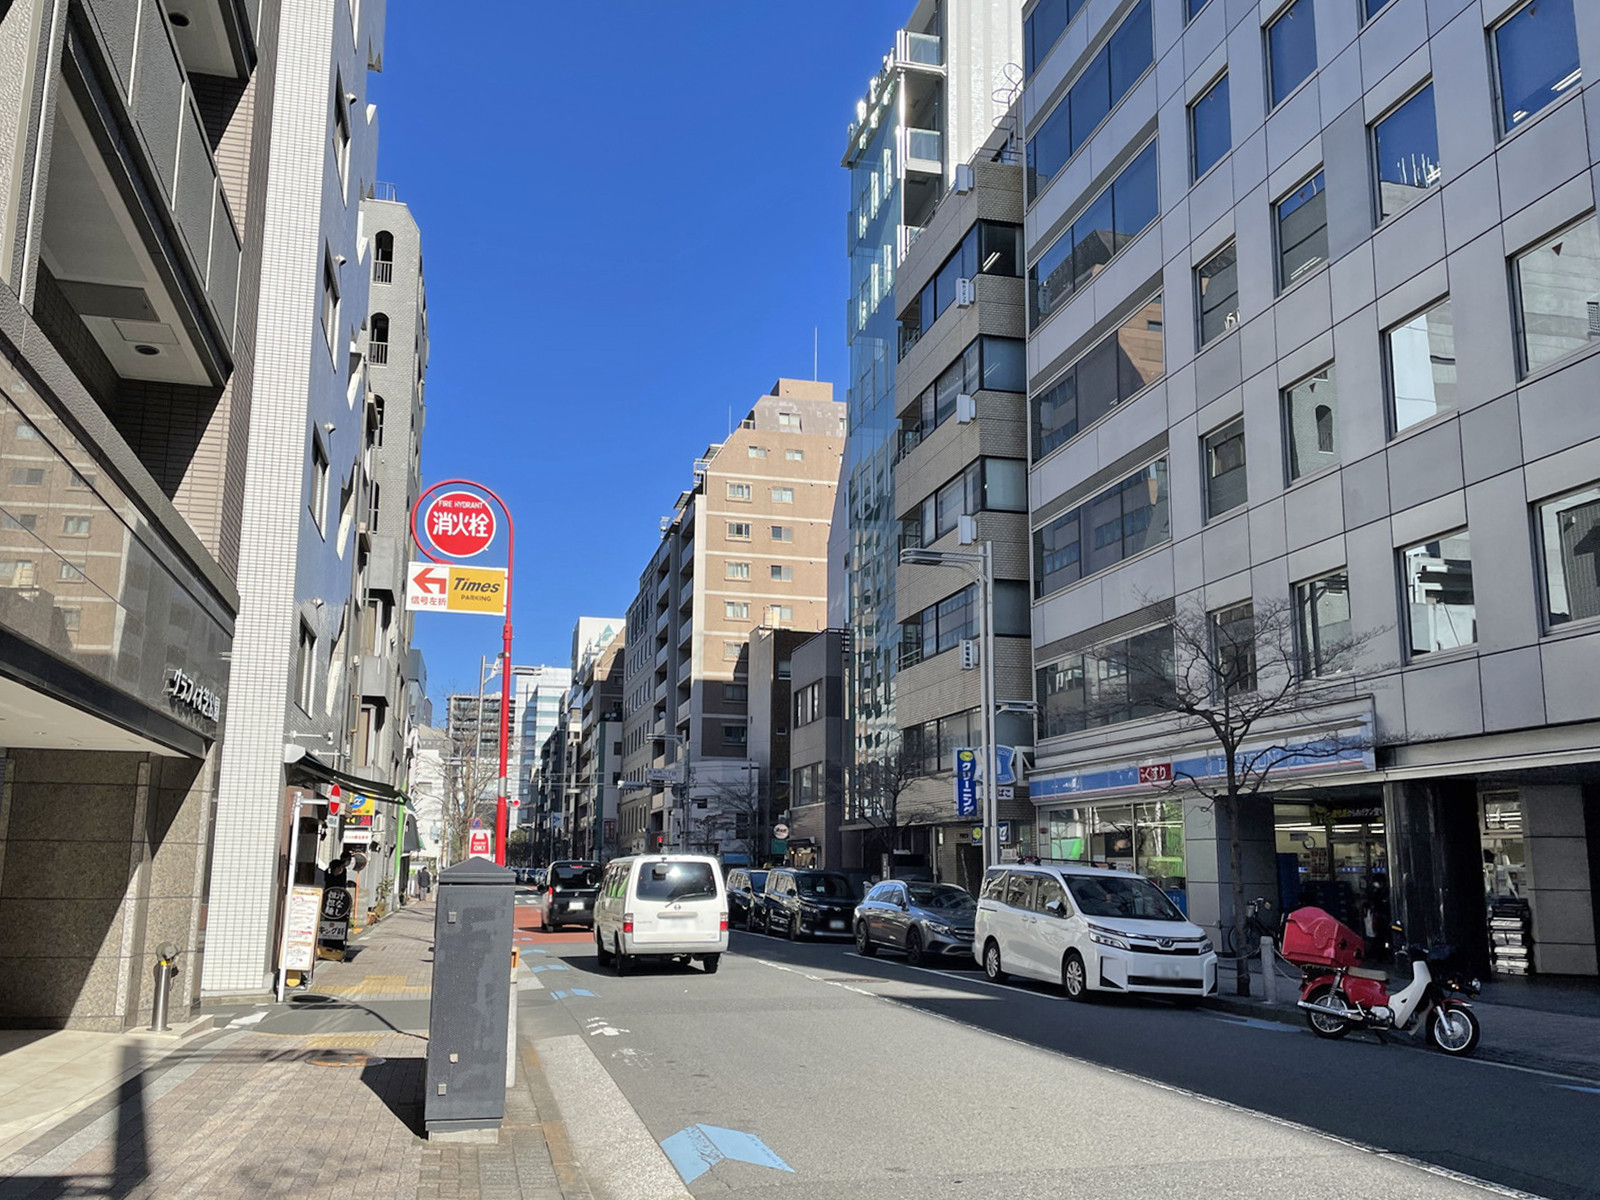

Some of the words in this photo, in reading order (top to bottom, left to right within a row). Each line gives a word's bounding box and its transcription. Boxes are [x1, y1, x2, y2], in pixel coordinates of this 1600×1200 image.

[455, 501, 483, 509] HYDRANT
[433, 511, 489, 537] 消火栓
[453, 577, 500, 593] Times
[411, 595, 446, 606] 信号左折
[461, 594, 491, 602] PARKING
[1217, 750, 1277, 774] LWSON
[1145, 766, 1166, 781] くすり
[961, 761, 975, 815] クリーニング
